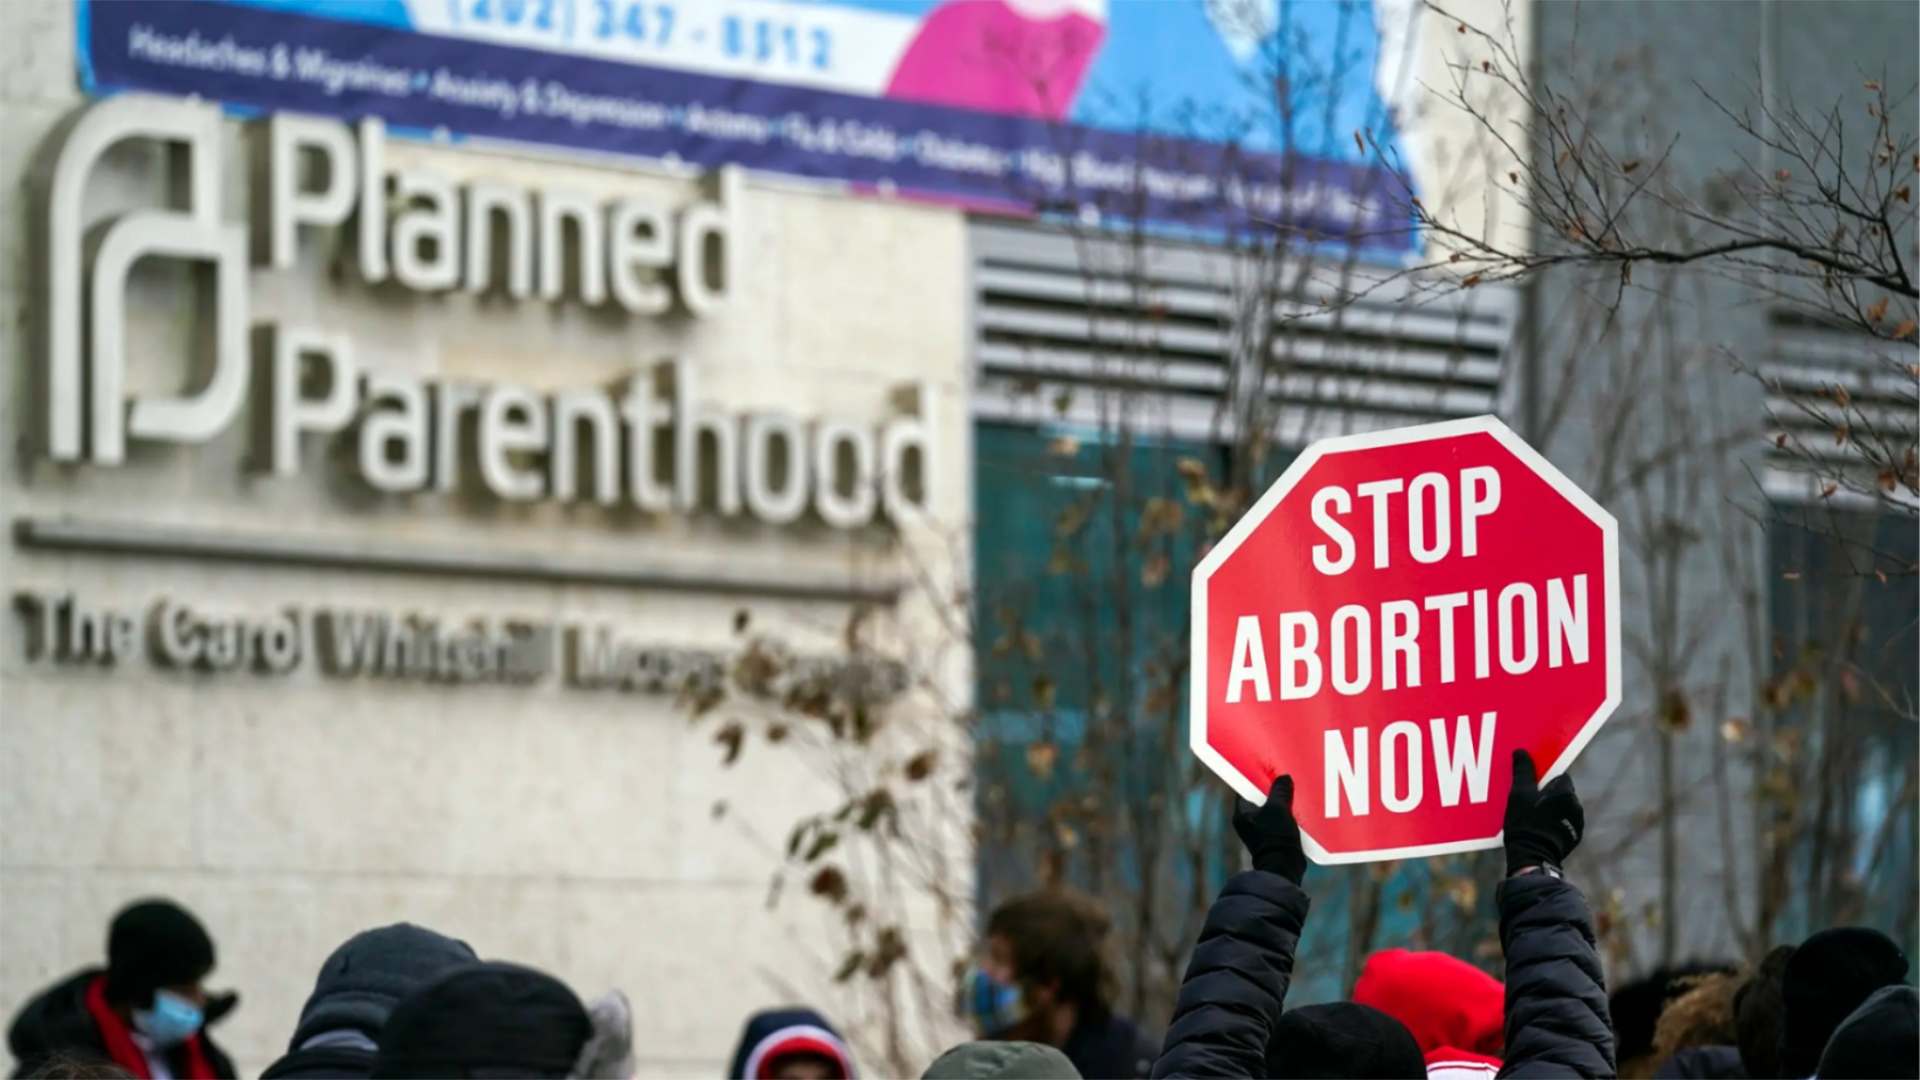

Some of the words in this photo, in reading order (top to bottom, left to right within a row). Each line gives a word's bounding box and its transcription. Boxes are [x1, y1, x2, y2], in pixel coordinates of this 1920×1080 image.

[270, 110, 744, 316] Planned
[274, 326, 940, 528] Parenthood
[1311, 466, 1501, 575] STOP
[1225, 573, 1590, 703] ABORTION
[1324, 711, 1497, 818] NOW
